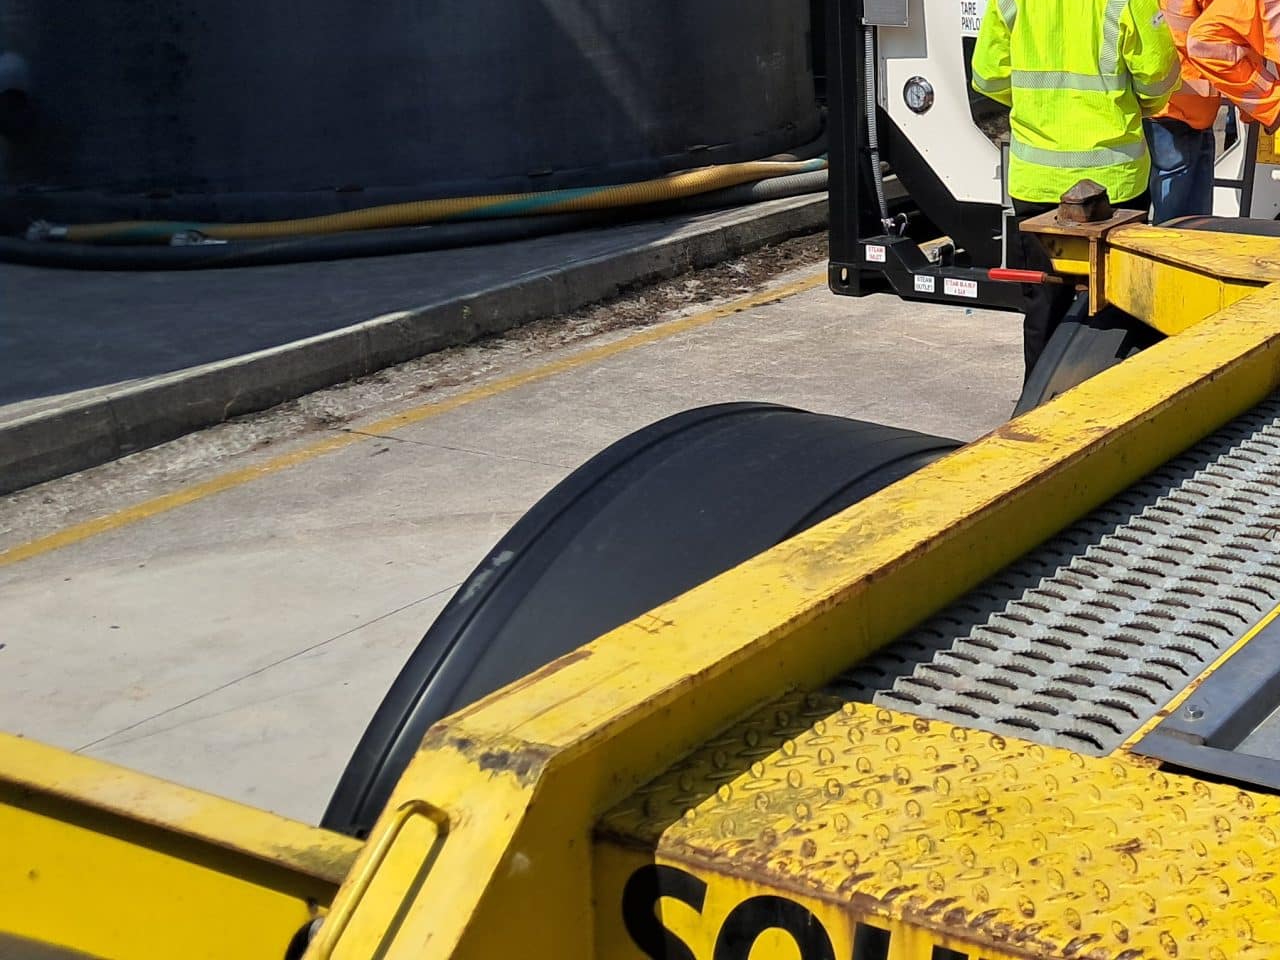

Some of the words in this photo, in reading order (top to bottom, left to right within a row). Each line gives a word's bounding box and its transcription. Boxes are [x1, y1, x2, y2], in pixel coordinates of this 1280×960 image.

[961, 2, 977, 16] TARE
[962, 17, 981, 31] PAYLO
[622, 863, 968, 960] SO
